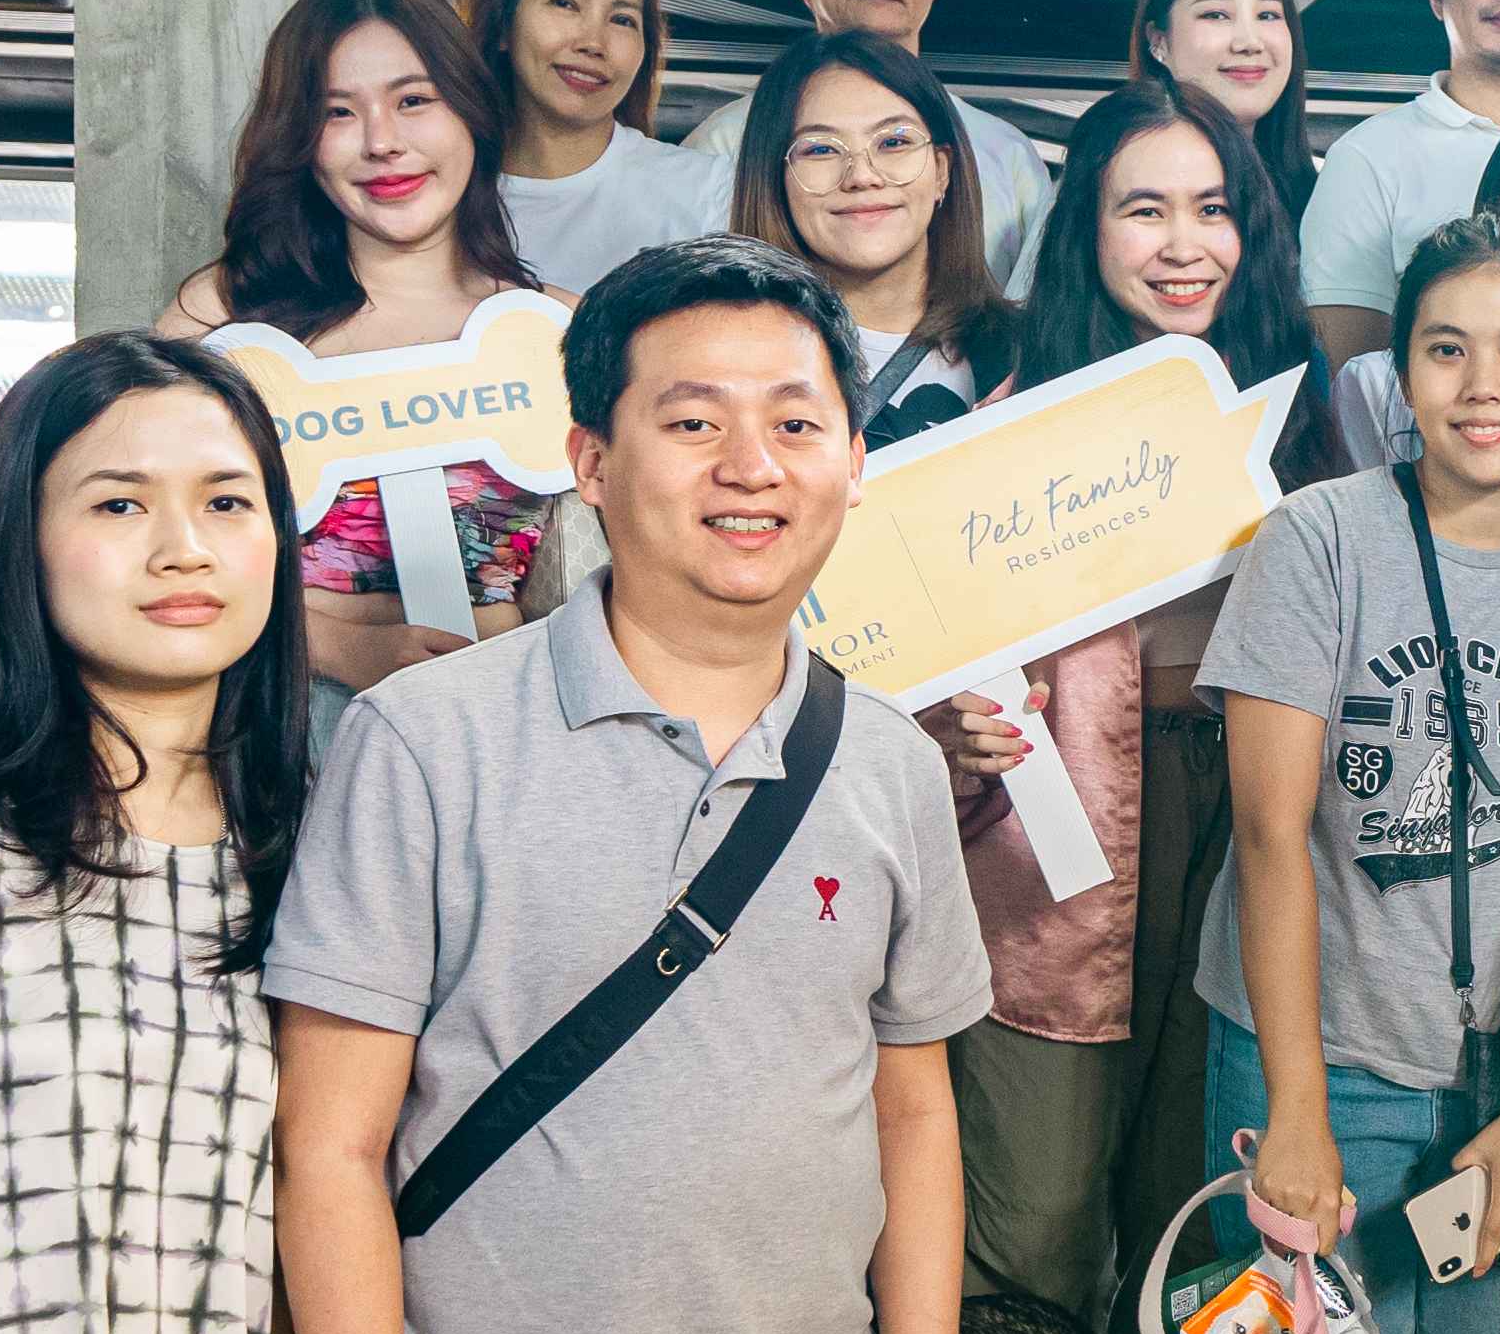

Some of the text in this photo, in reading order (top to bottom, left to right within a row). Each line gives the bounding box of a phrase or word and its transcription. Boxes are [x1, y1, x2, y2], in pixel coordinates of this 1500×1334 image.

[380, 381, 533, 430] LOVER
[960, 439, 1181, 565] Pet Family
[1005, 504, 1151, 575] Residences
[1366, 633, 1460, 690] LIO
[1345, 746, 1384, 769] SG
[1345, 768, 1380, 794] 50
